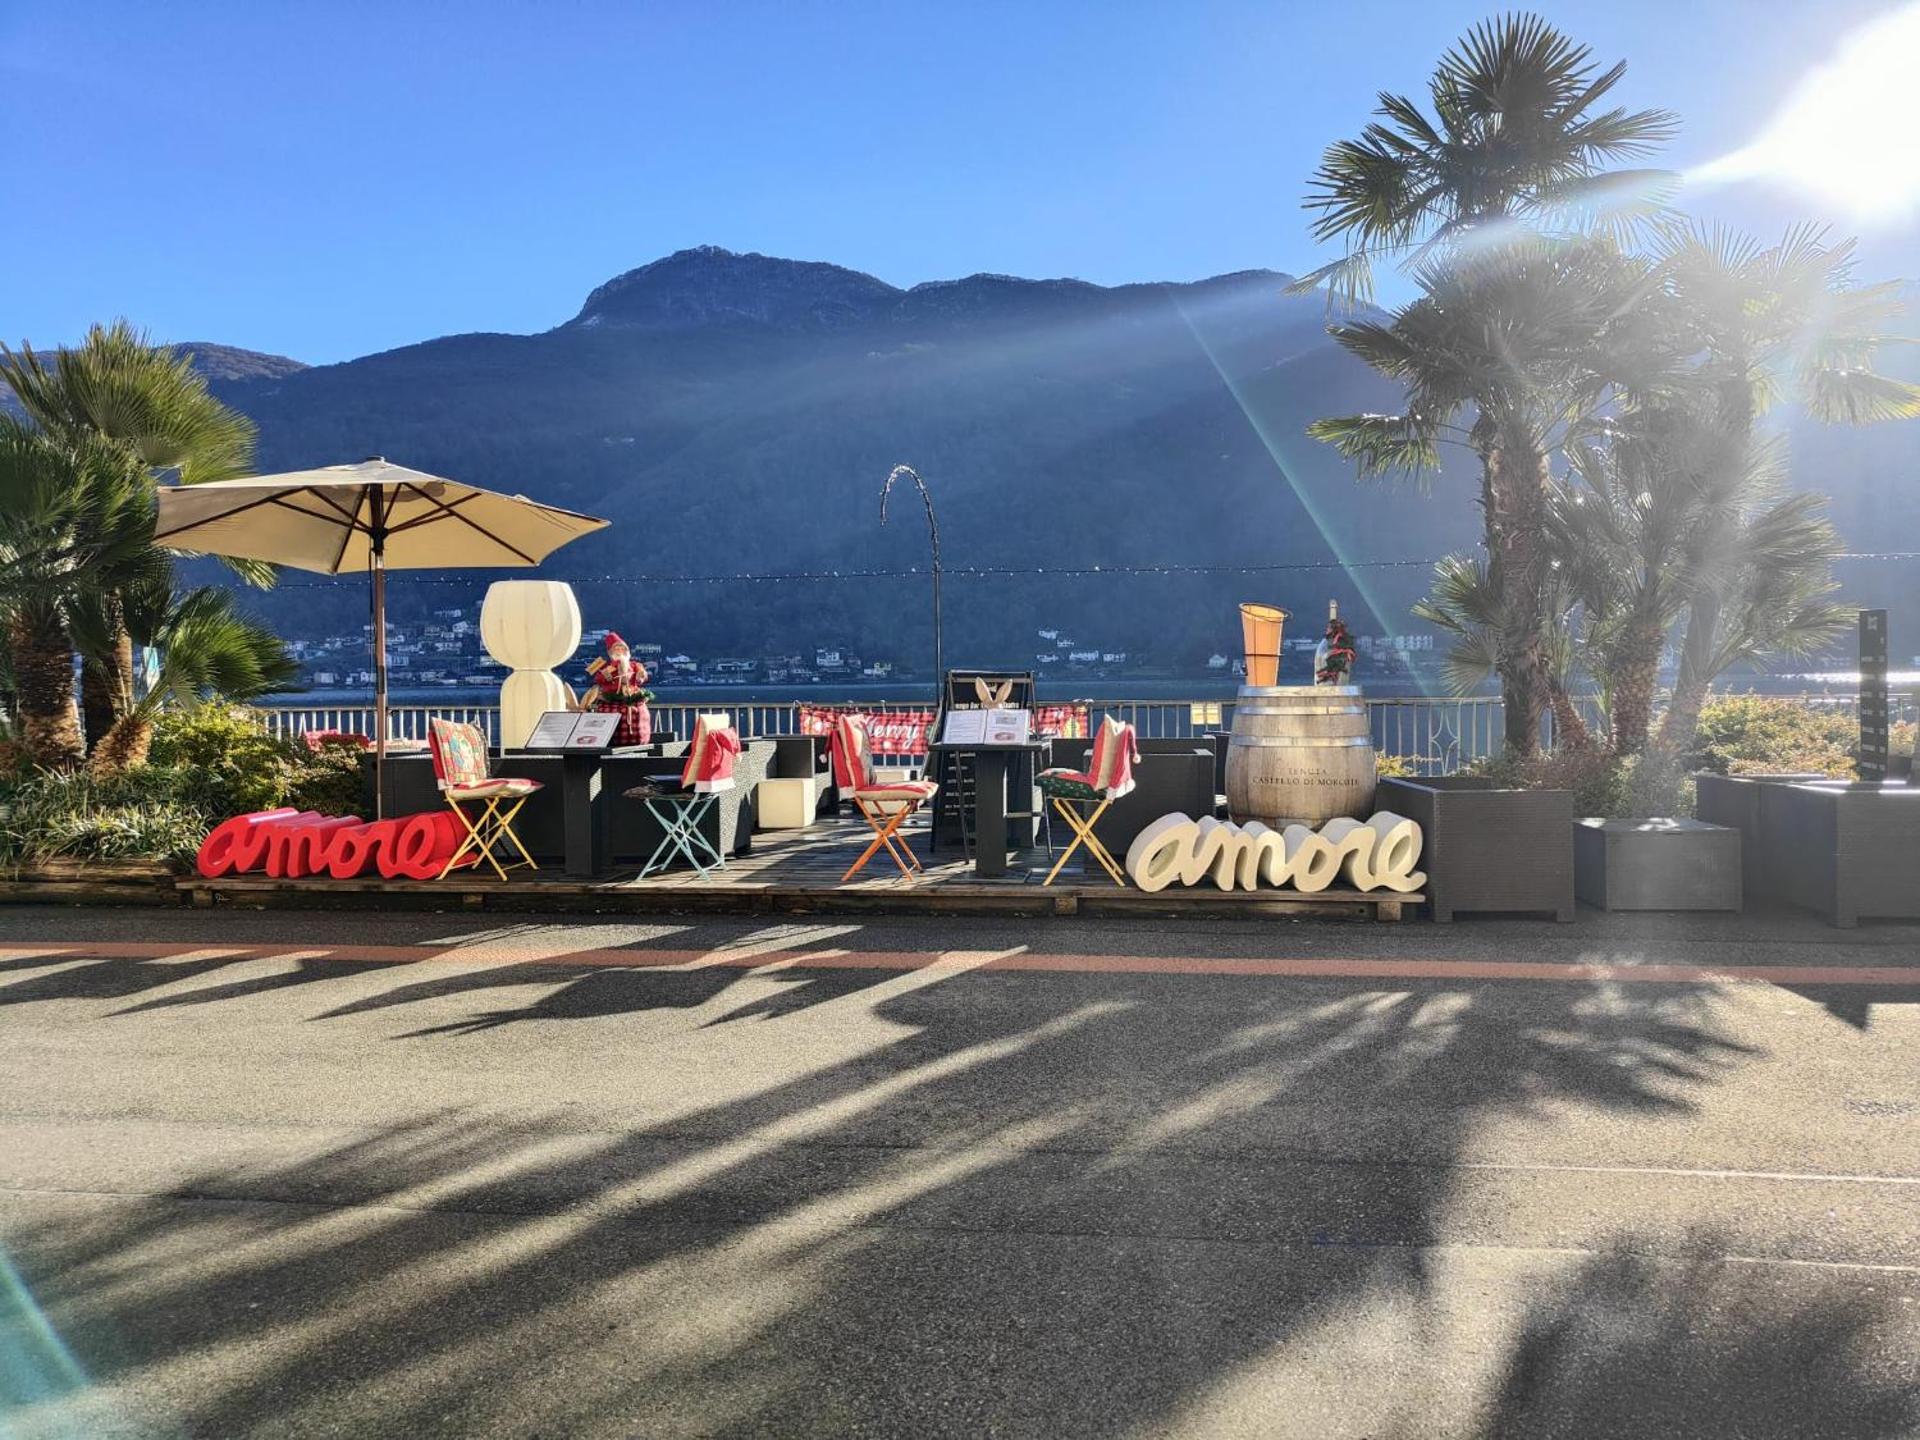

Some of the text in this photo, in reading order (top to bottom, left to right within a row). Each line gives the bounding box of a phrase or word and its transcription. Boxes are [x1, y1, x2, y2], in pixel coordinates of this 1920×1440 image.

[1253, 776, 1300, 786] CASTELLO
[1303, 778, 1314, 786] DI
[197, 808, 456, 880] amore
[1127, 812, 1427, 893] amore
